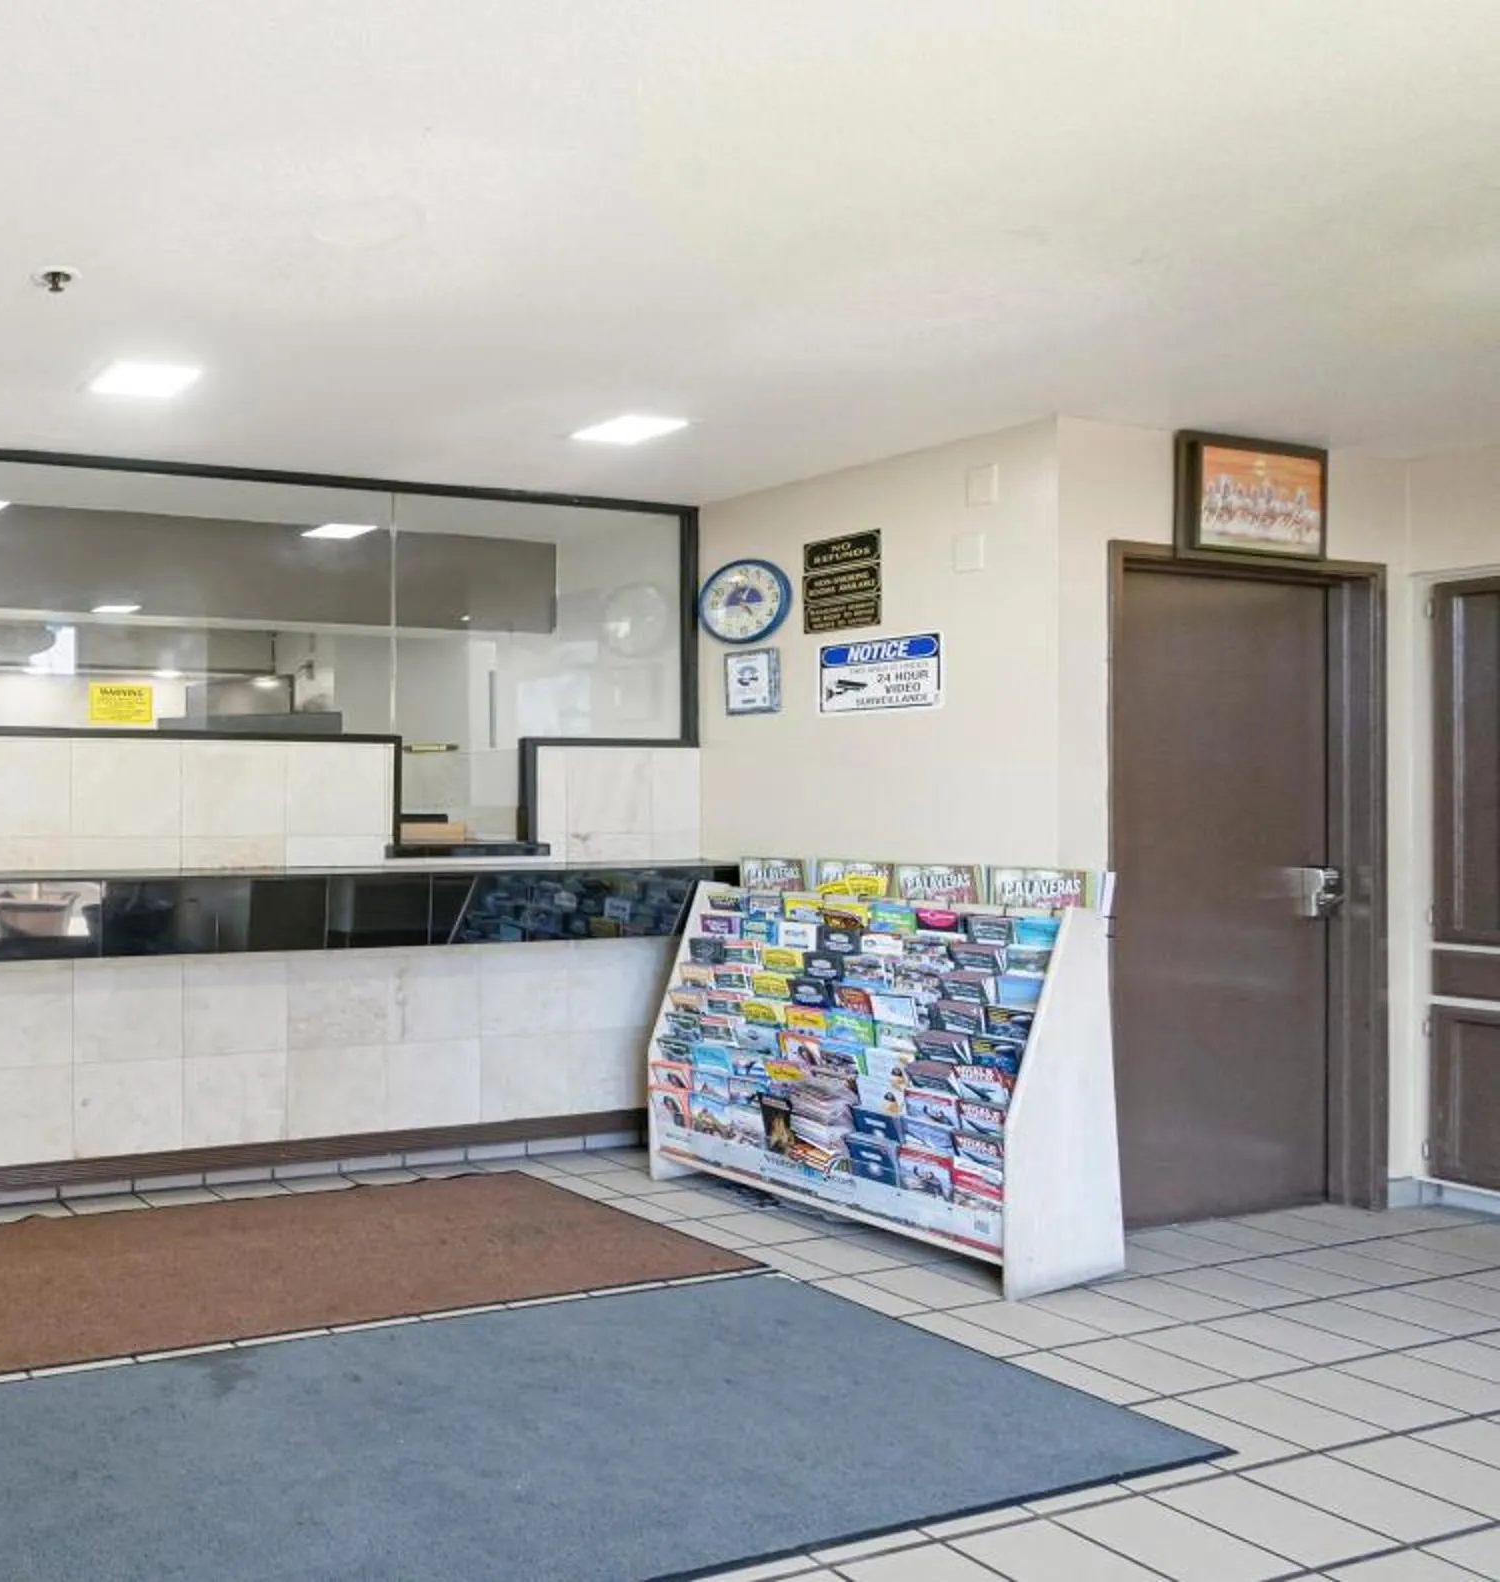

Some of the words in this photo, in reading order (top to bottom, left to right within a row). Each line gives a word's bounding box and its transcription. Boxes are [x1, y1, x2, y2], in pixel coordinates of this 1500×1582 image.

[813, 546, 871, 565] REFUNDS
[831, 541, 851, 553] NO
[846, 638, 911, 664] NOTICE
[876, 673, 891, 684] 24
[895, 669, 929, 681] HOUR
[884, 682, 922, 695] VIDEO
[1004, 878, 1082, 898] CALAVERAS
